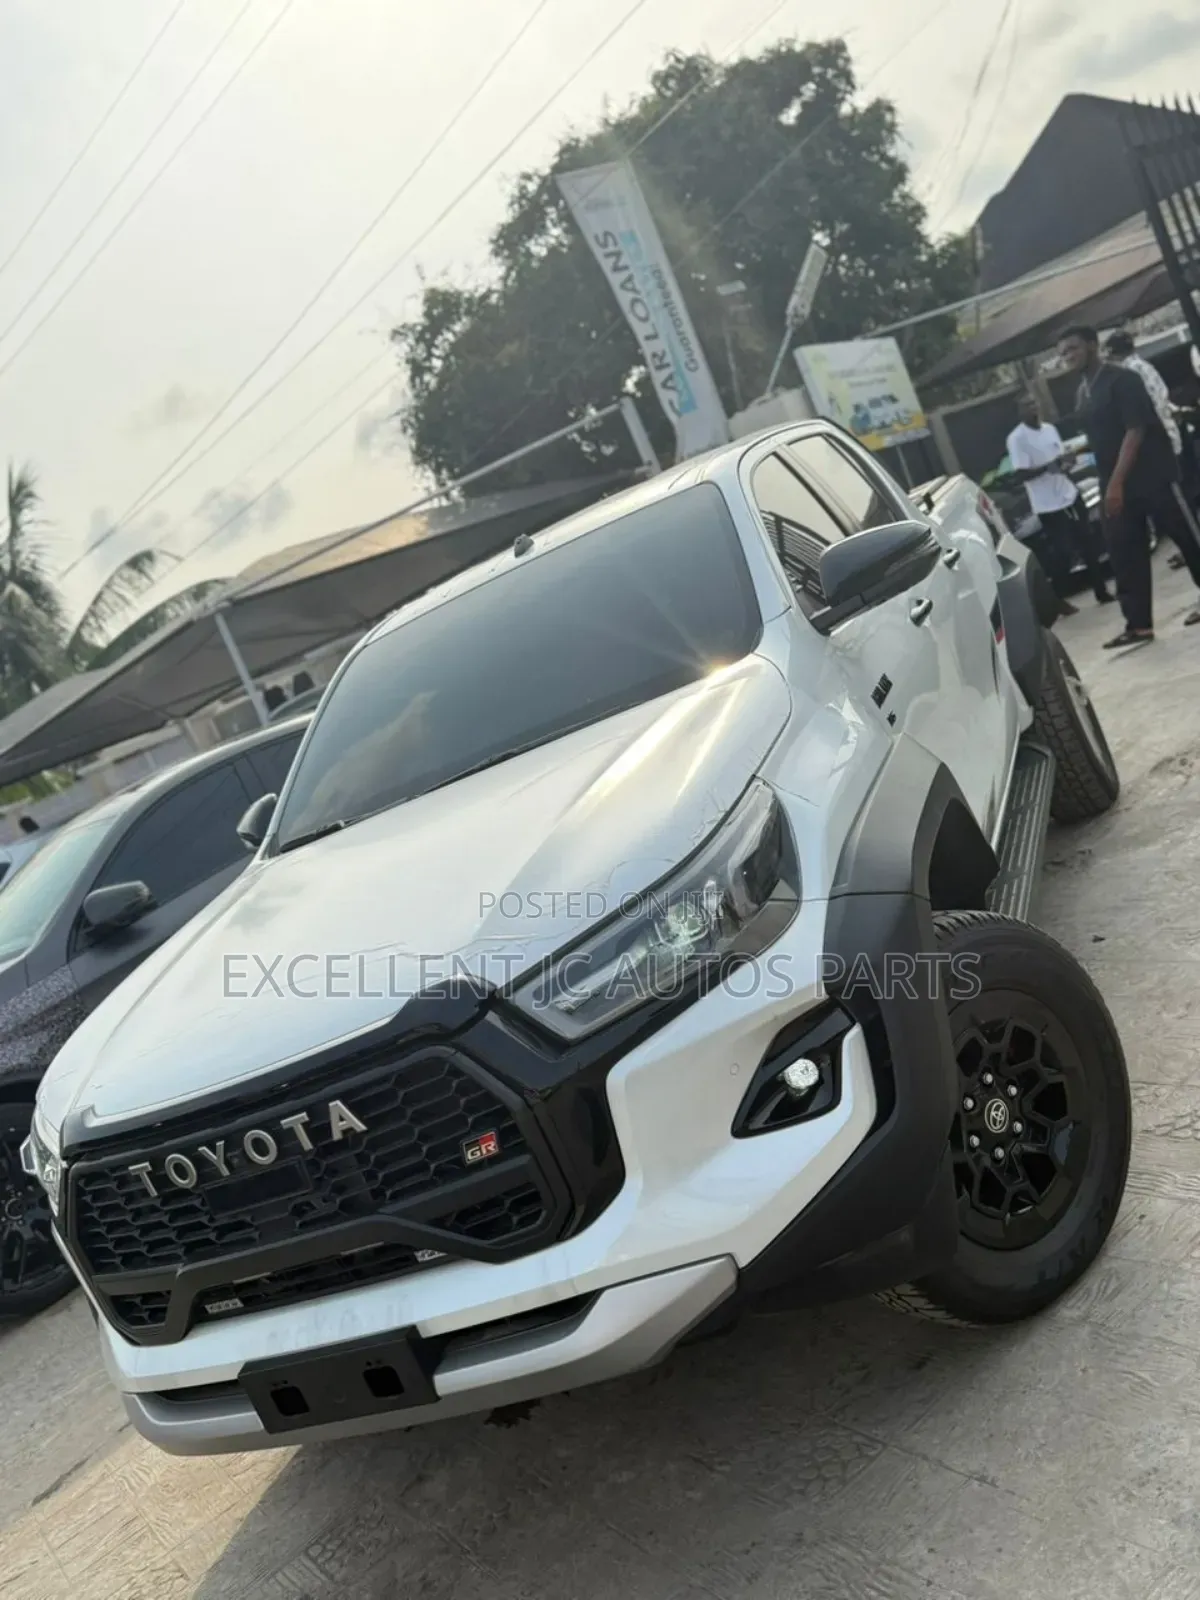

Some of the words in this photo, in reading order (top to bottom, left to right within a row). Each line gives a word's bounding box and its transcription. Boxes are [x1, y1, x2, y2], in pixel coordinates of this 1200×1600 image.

[594, 230, 660, 342] LOANS
[128, 1100, 367, 1197] TOYOTA
[466, 1139, 497, 1161] GR
